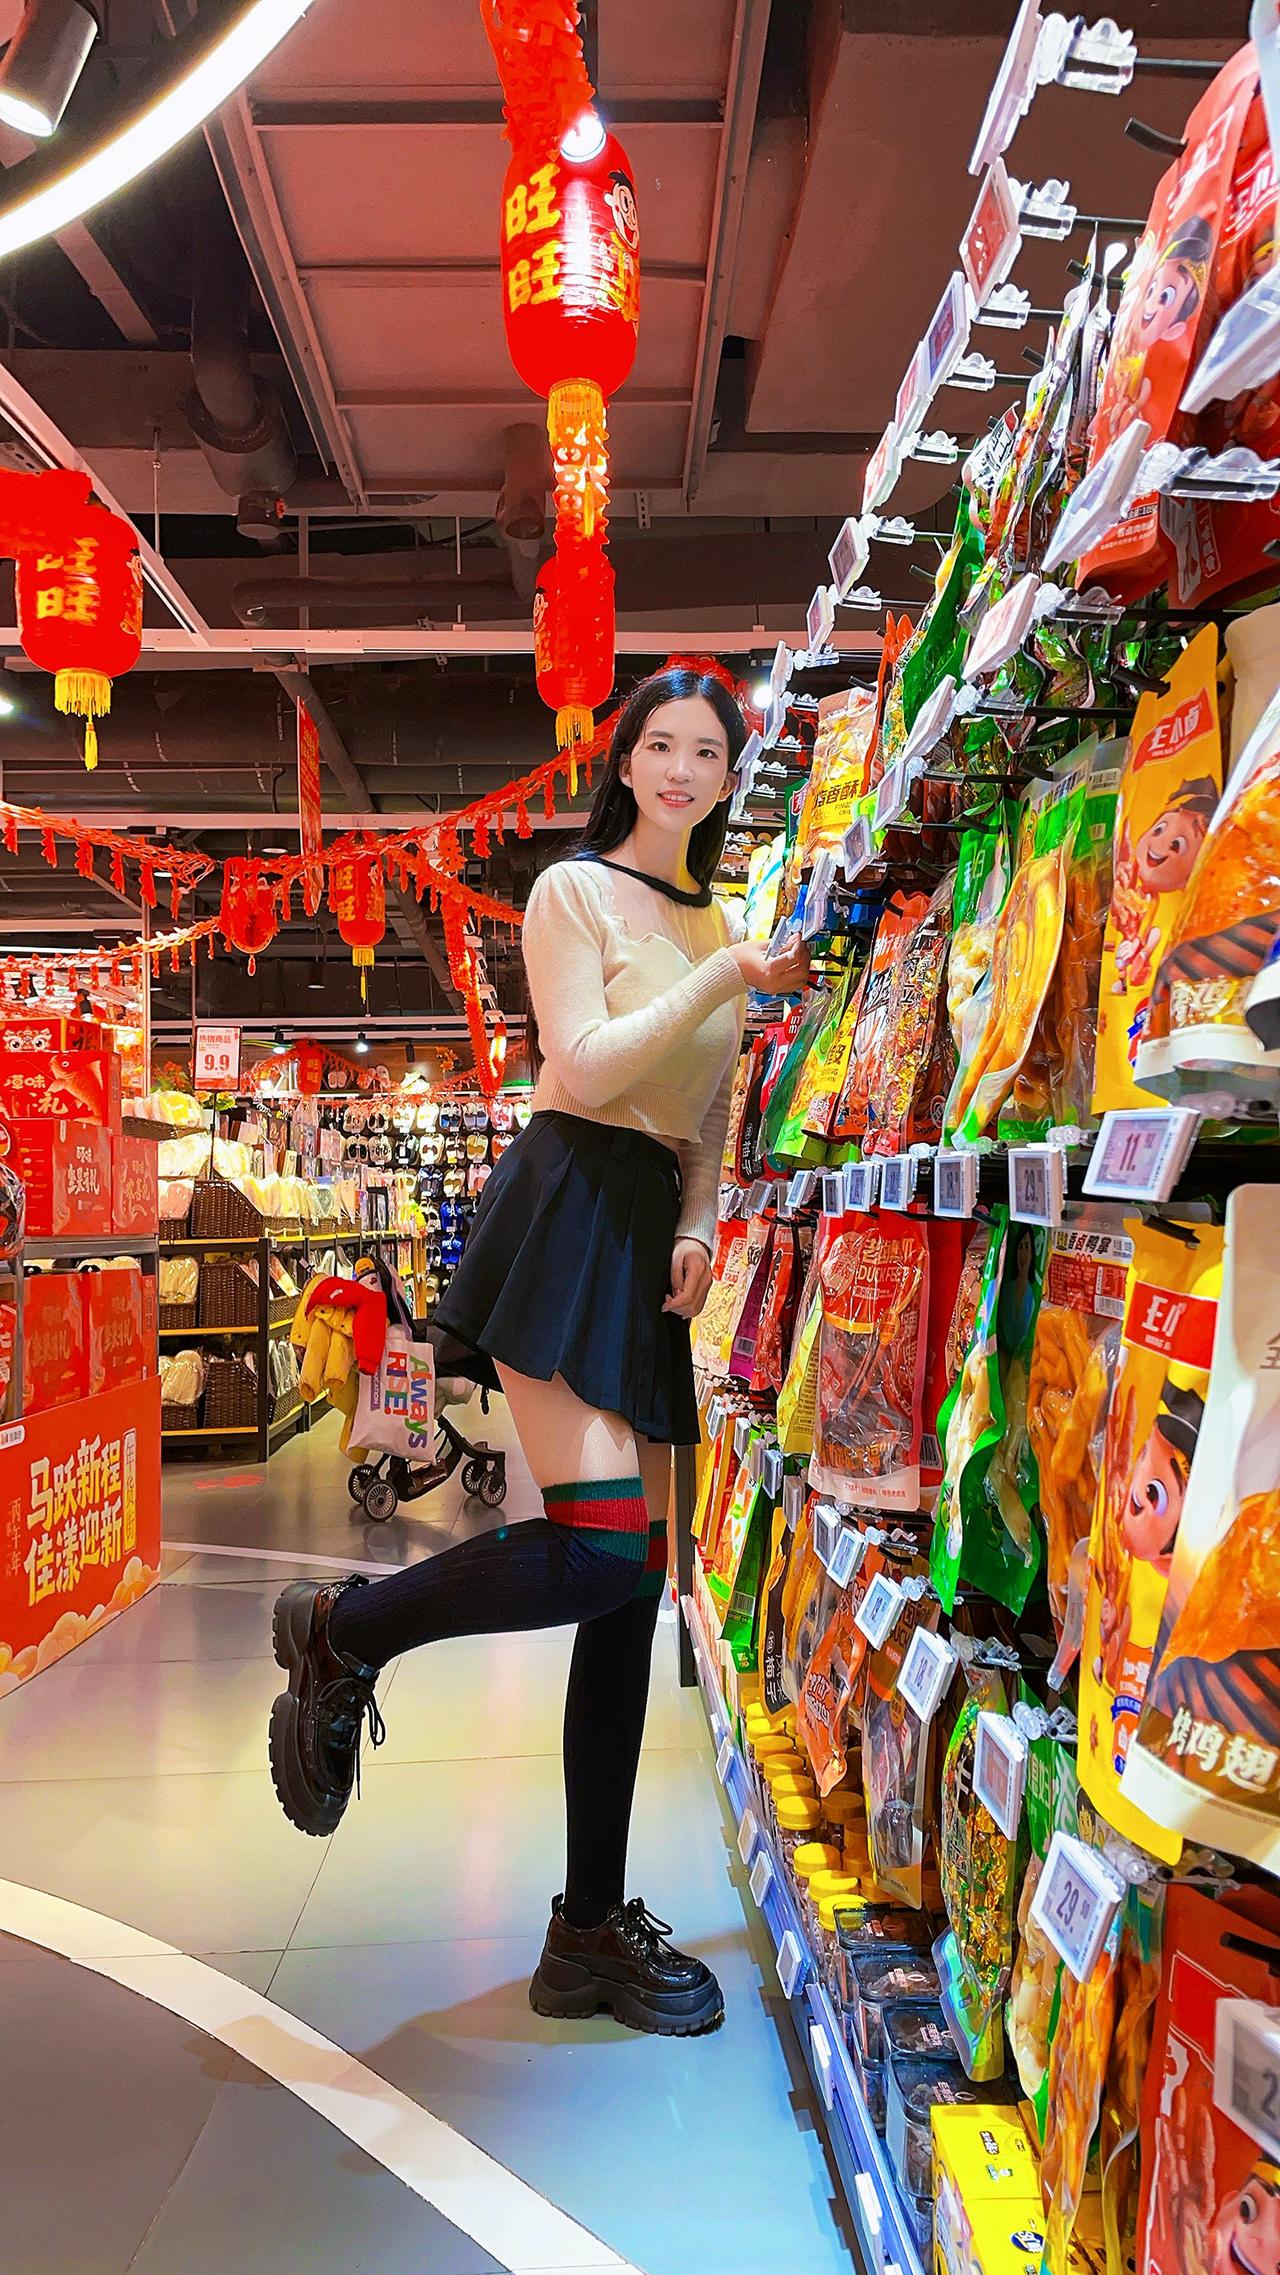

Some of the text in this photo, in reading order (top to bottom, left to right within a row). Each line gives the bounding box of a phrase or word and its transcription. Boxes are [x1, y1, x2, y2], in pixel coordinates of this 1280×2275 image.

[204, 1054, 230, 1071] 9.9
[384, 1351, 409, 1416] RISE!
[404, 1356, 433, 1449] Always
[27, 1434, 122, 1531] 马跃新程
[23, 1495, 123, 1606] 佳漾迎新
[1167, 1705, 1278, 1793] 烤鸡翅
